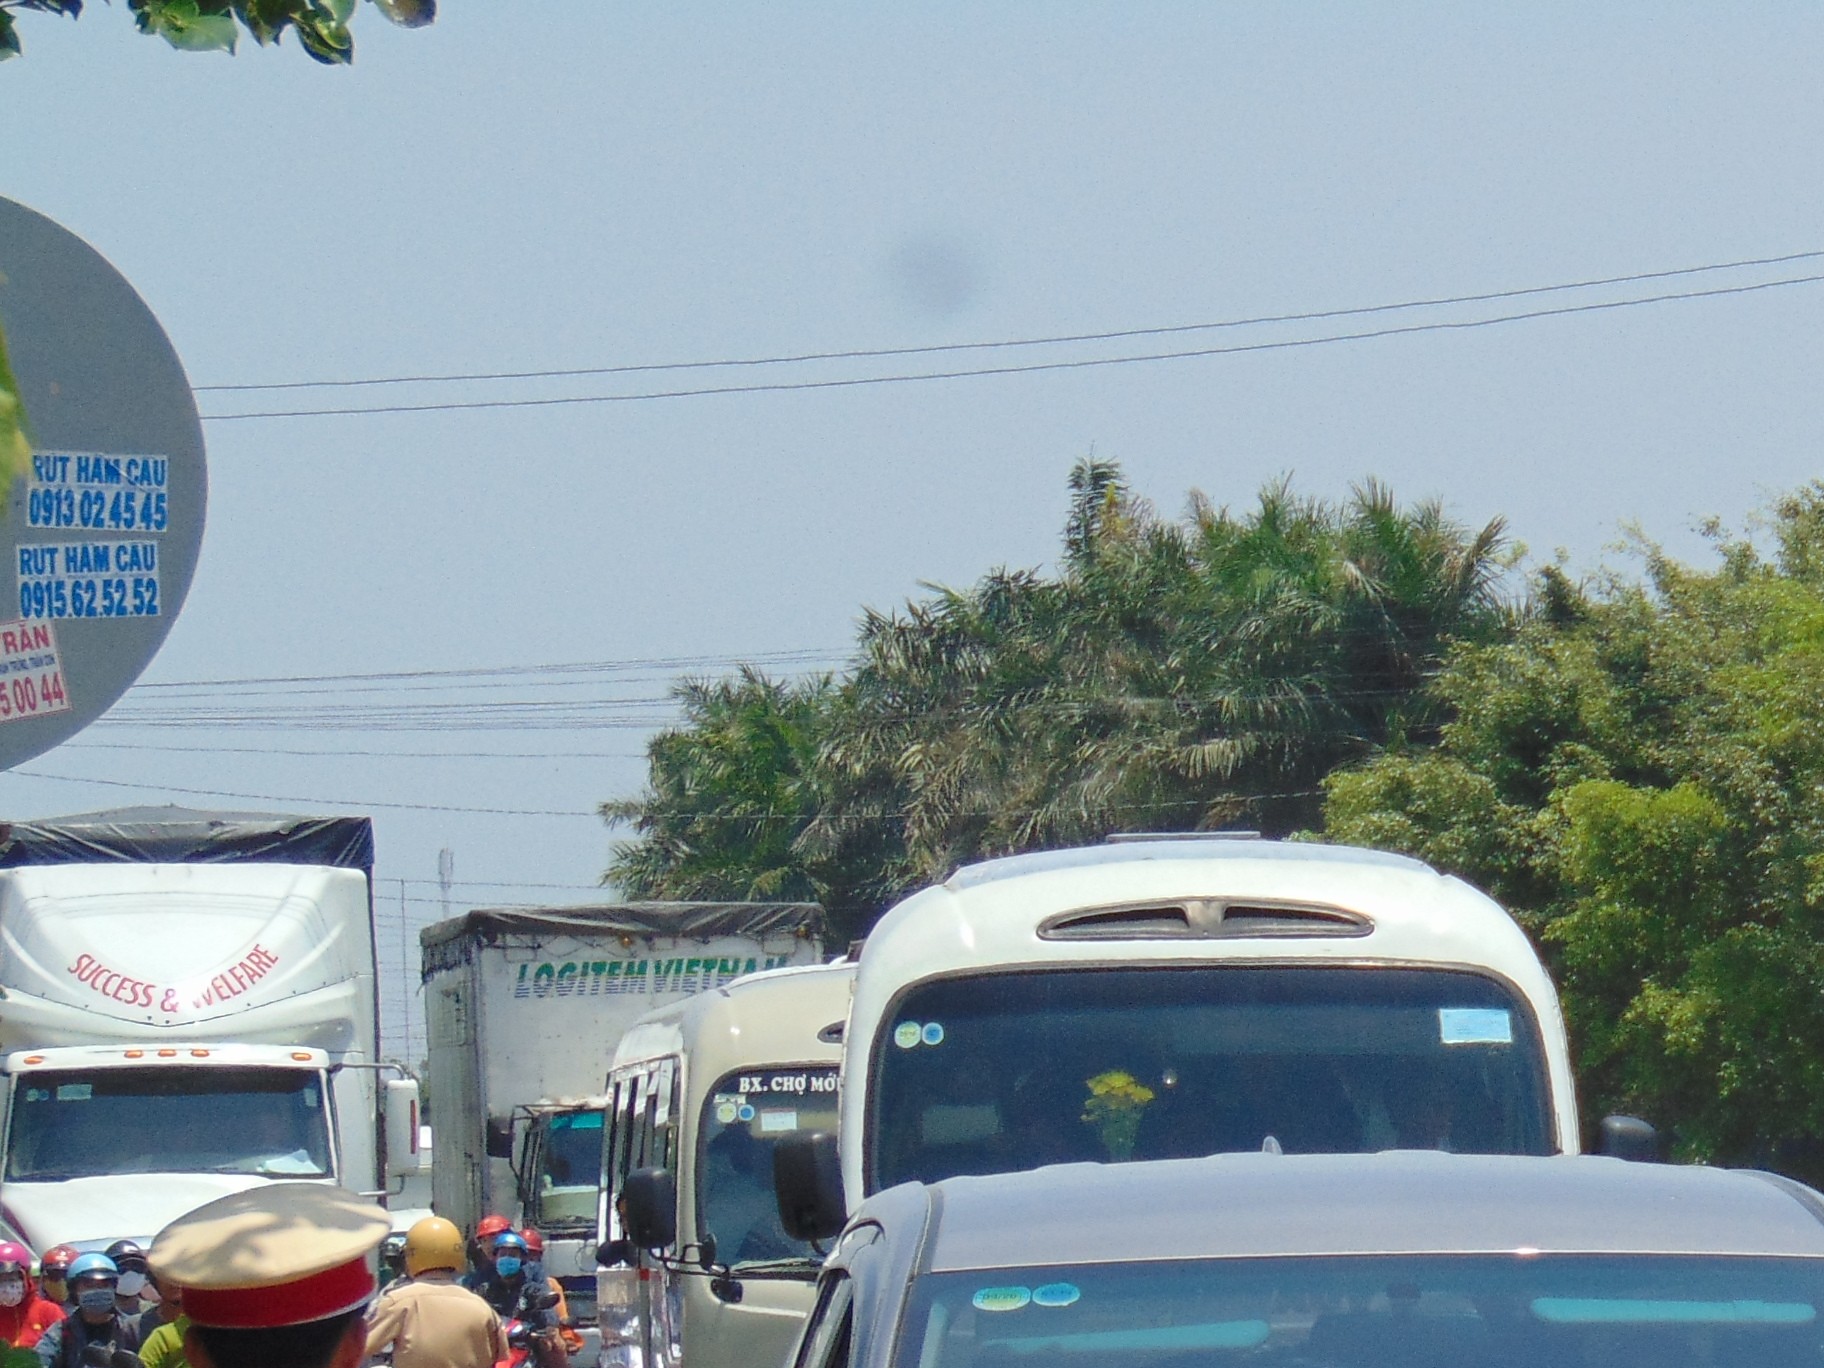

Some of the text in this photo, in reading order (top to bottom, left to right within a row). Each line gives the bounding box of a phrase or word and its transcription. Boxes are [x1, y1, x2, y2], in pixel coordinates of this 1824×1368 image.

[33, 455, 166, 487] RUT HAM CAU
[29, 488, 168, 531] 0913.02.45.45
[19, 543, 156, 576] RUT HAM CAU
[20, 577, 158, 619] 0915.62.52.52
[67, 953, 157, 1008] SUCCESS
[160, 988, 179, 1013] &
[514, 959, 649, 998] LOGITEM
[739, 1077, 768, 1092] BX.
[771, 1073, 807, 1095] CHỢ
